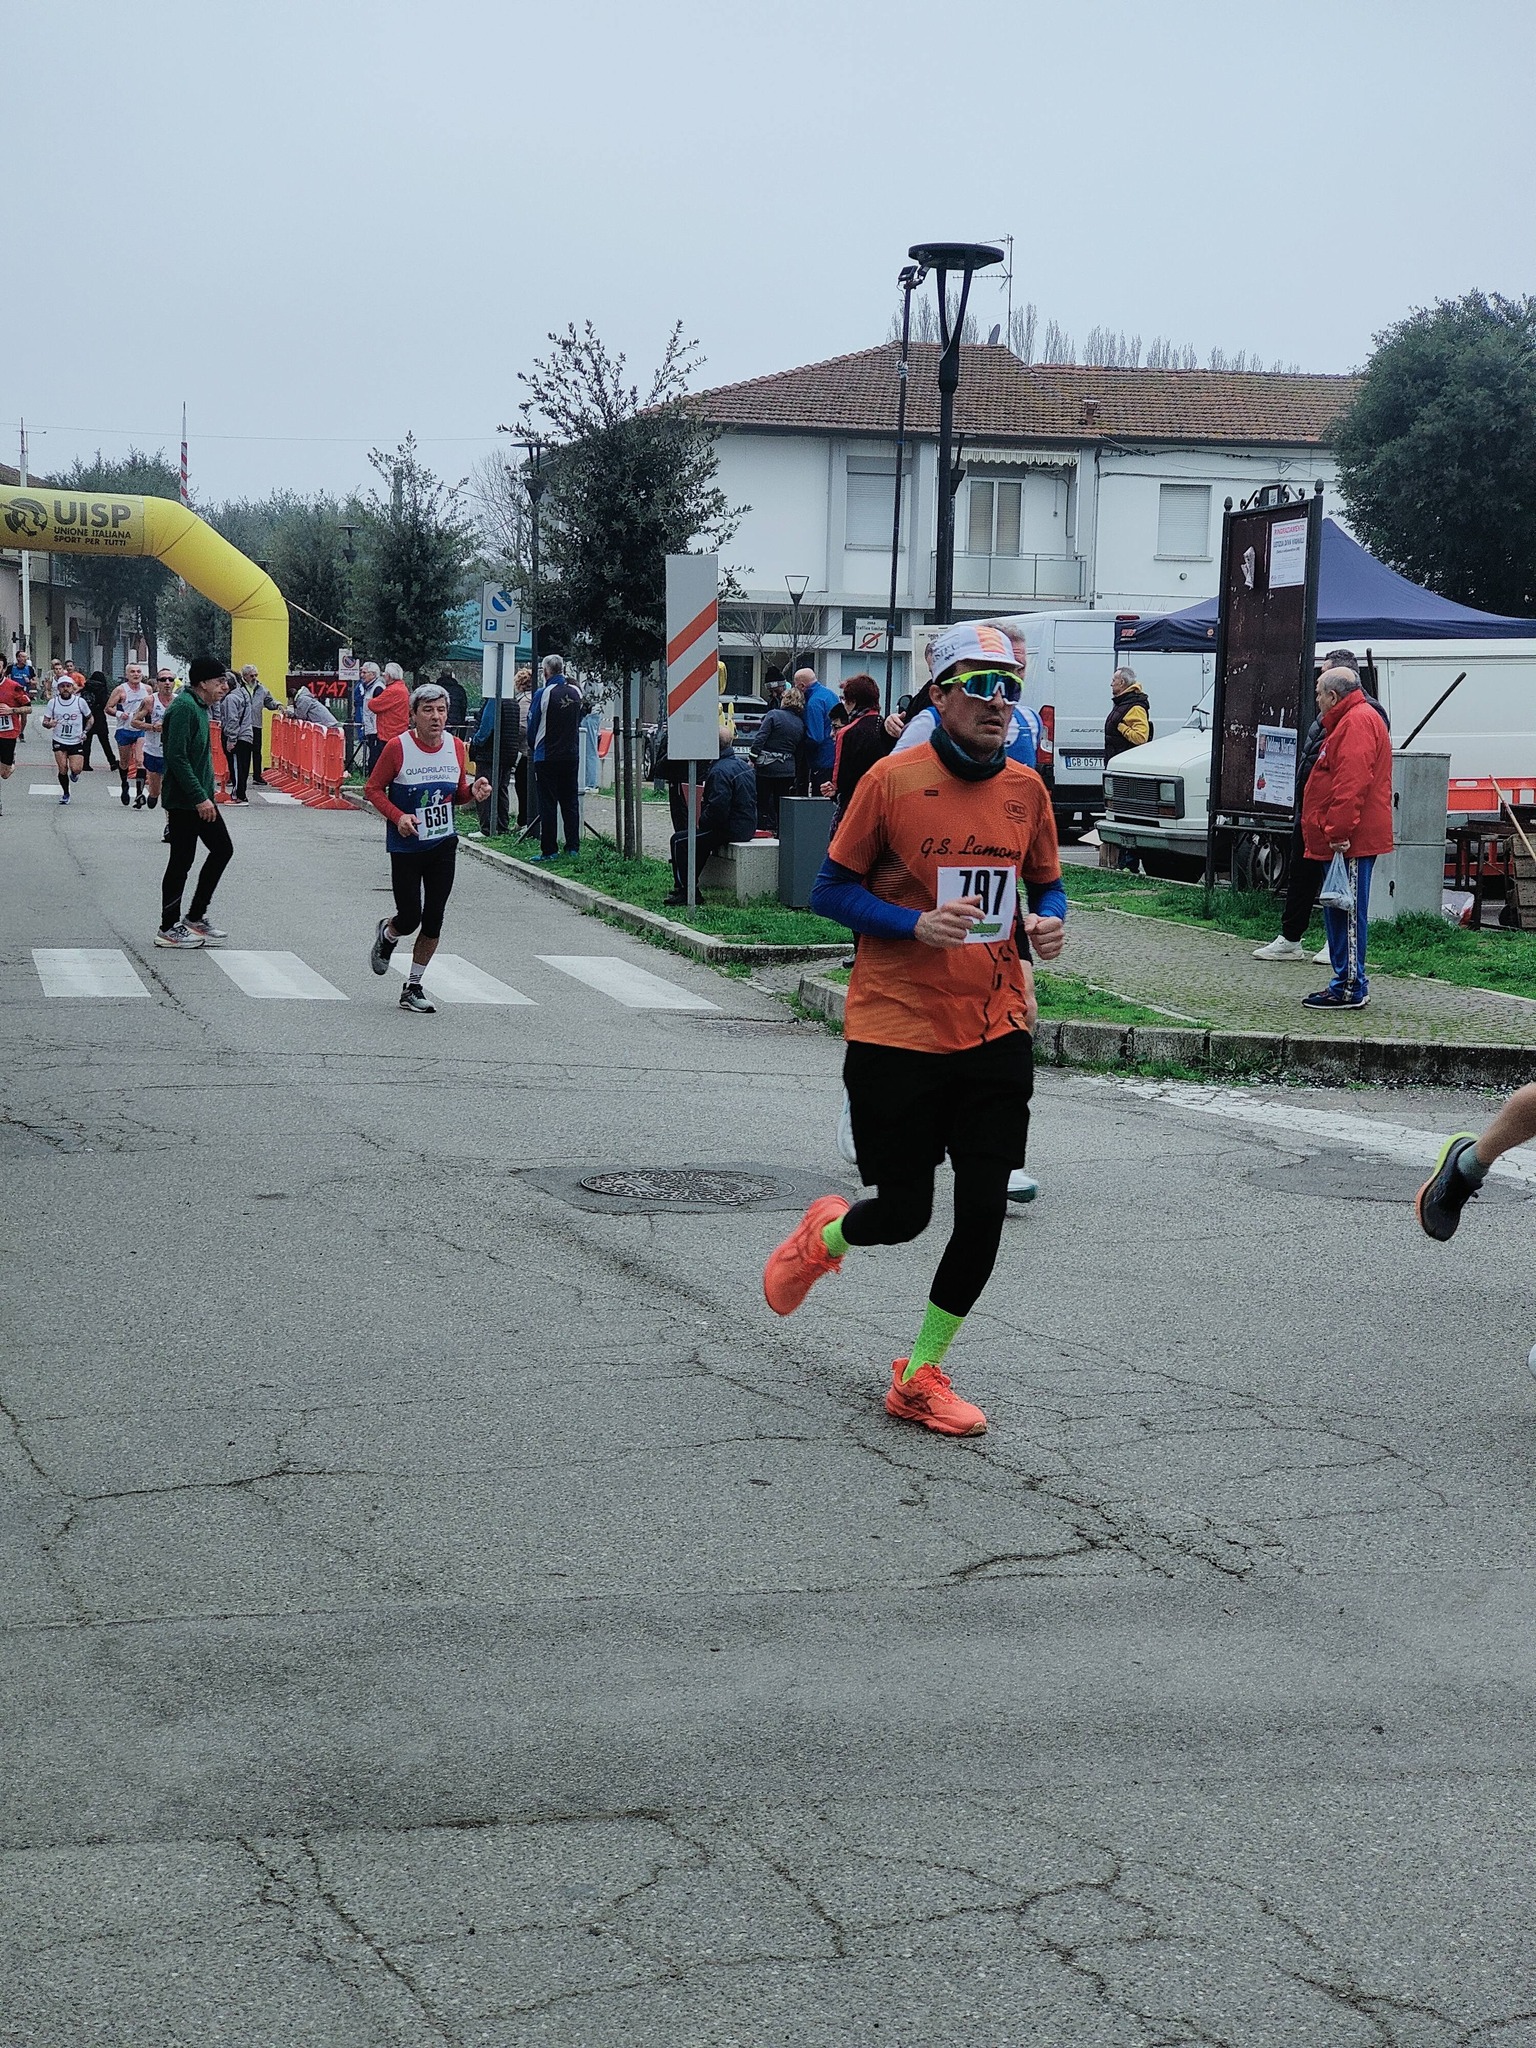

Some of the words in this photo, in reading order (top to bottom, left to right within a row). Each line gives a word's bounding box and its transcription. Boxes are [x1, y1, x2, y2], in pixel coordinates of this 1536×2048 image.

[54, 500, 131, 528] UISP
[54, 526, 88, 536] UNIONE
[91, 529, 131, 539] ITALIANA
[54, 534, 81, 544] SPORT
[85, 537, 99, 545] PER
[104, 538, 126, 546] TUTTI
[308, 681, 347, 697] 17:47
[406, 766, 458, 776] QUADRILATERO
[425, 804, 449, 829] 639
[921, 837, 953, 859] G.S.
[959, 869, 1009, 916] 797
